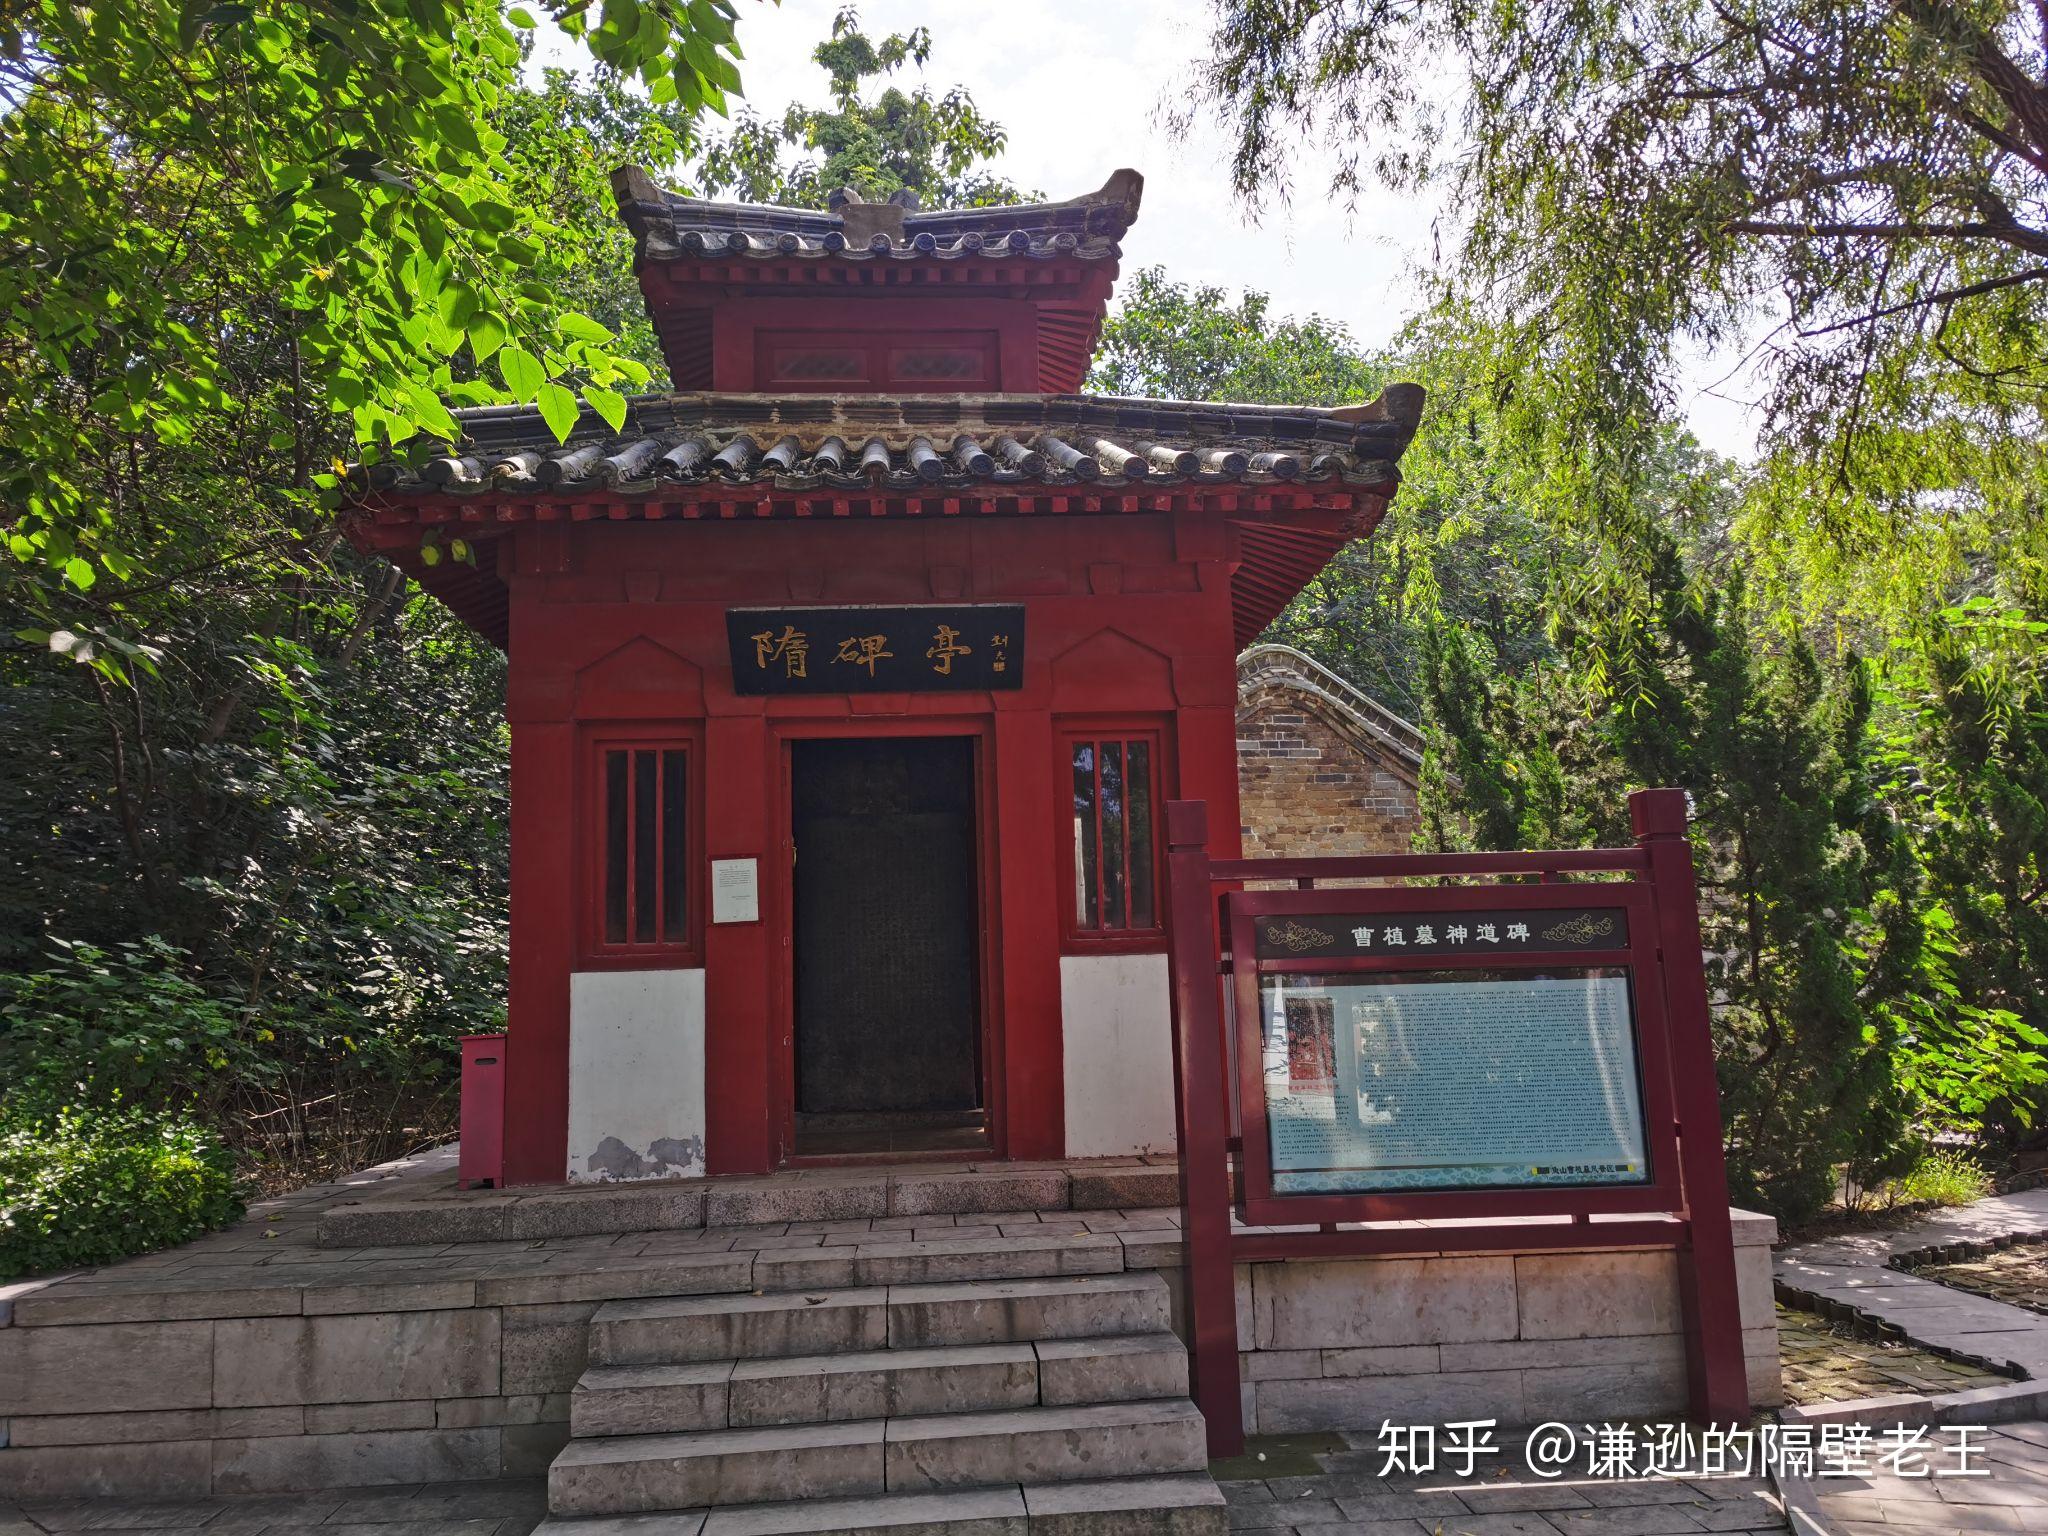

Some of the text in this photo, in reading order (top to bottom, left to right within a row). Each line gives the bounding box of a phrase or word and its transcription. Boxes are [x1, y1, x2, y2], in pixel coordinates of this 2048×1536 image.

[751, 625, 972, 678] 隋碑亭
[1351, 922, 1531, 947] 曹植墓神道碑
